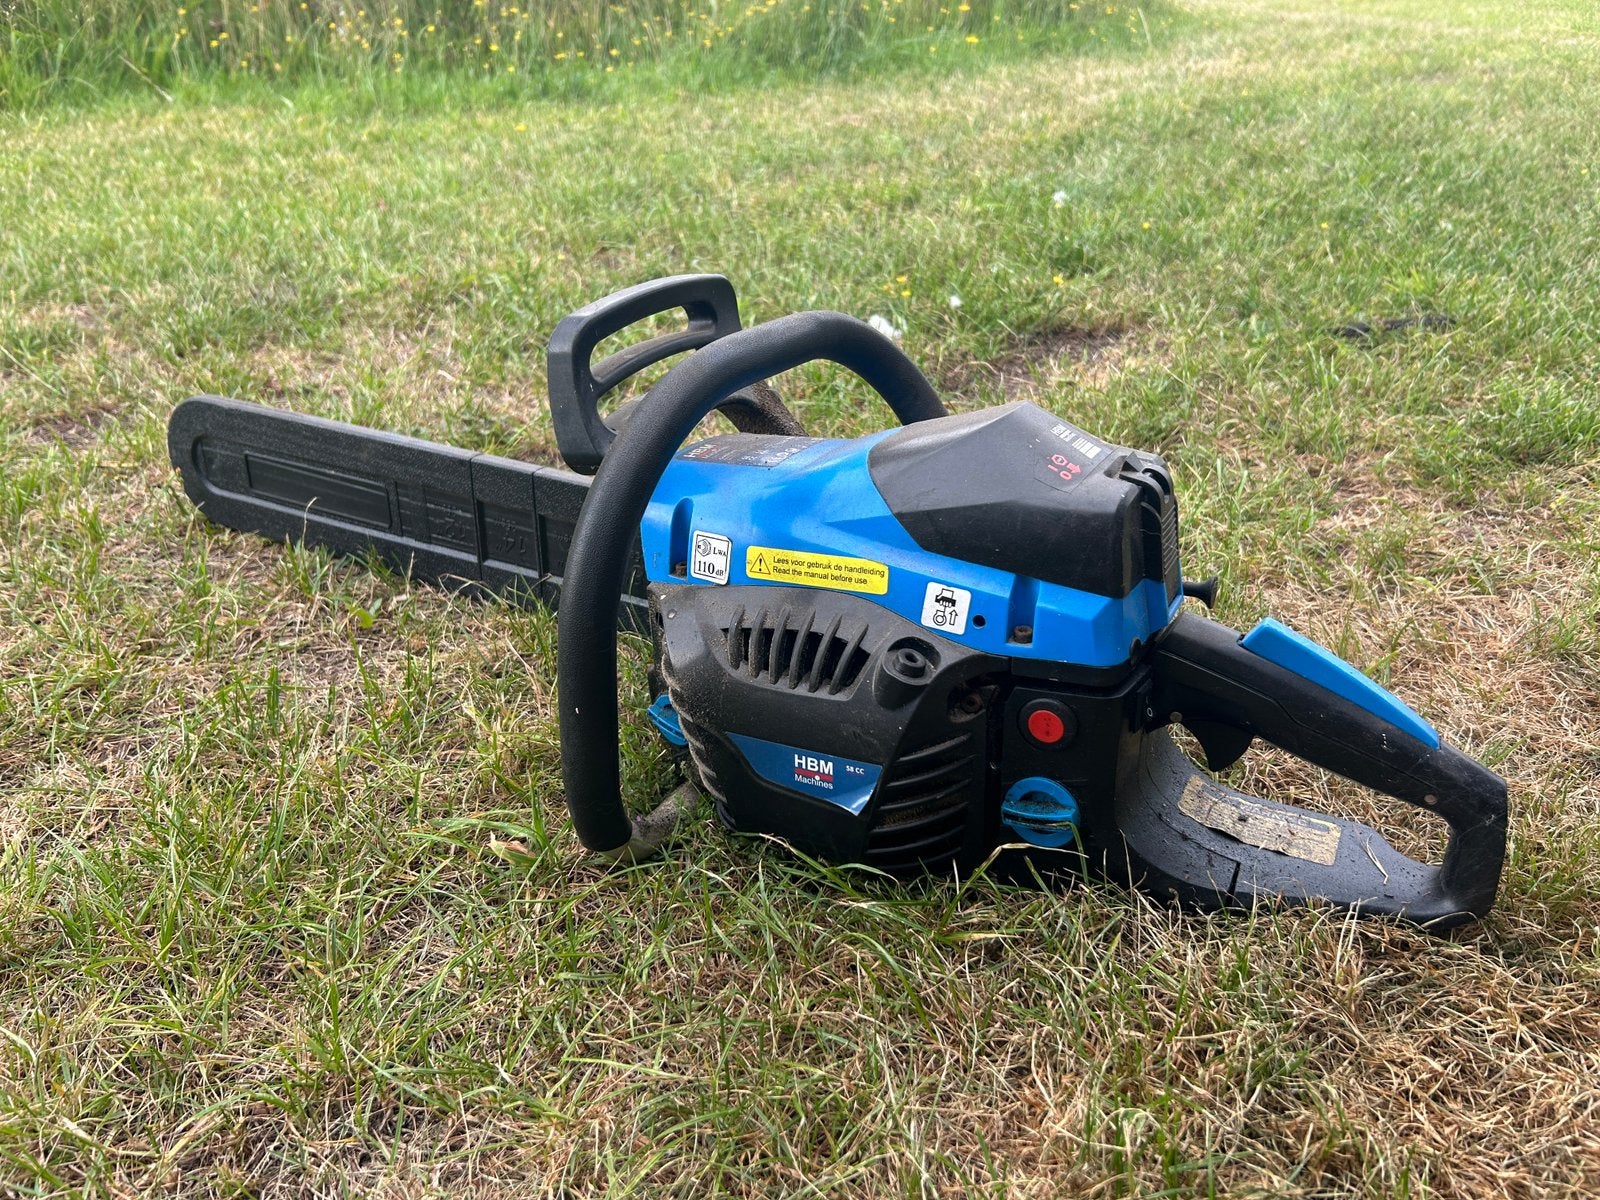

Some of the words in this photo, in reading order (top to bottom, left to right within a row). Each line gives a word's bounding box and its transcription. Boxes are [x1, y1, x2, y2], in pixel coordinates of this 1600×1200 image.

[698, 560, 715, 575] 110
[772, 566, 790, 575] Read
[791, 568, 803, 576] the
[804, 570, 829, 580] manual
[830, 573, 853, 583] before
[773, 556, 789, 565] Lees
[807, 561, 832, 570] gebruik
[833, 564, 843, 572] de
[844, 565, 885, 578] handleiding
[794, 753, 834, 776] HBM
[845, 765, 854, 773] 58
[794, 773, 834, 790] Machines
